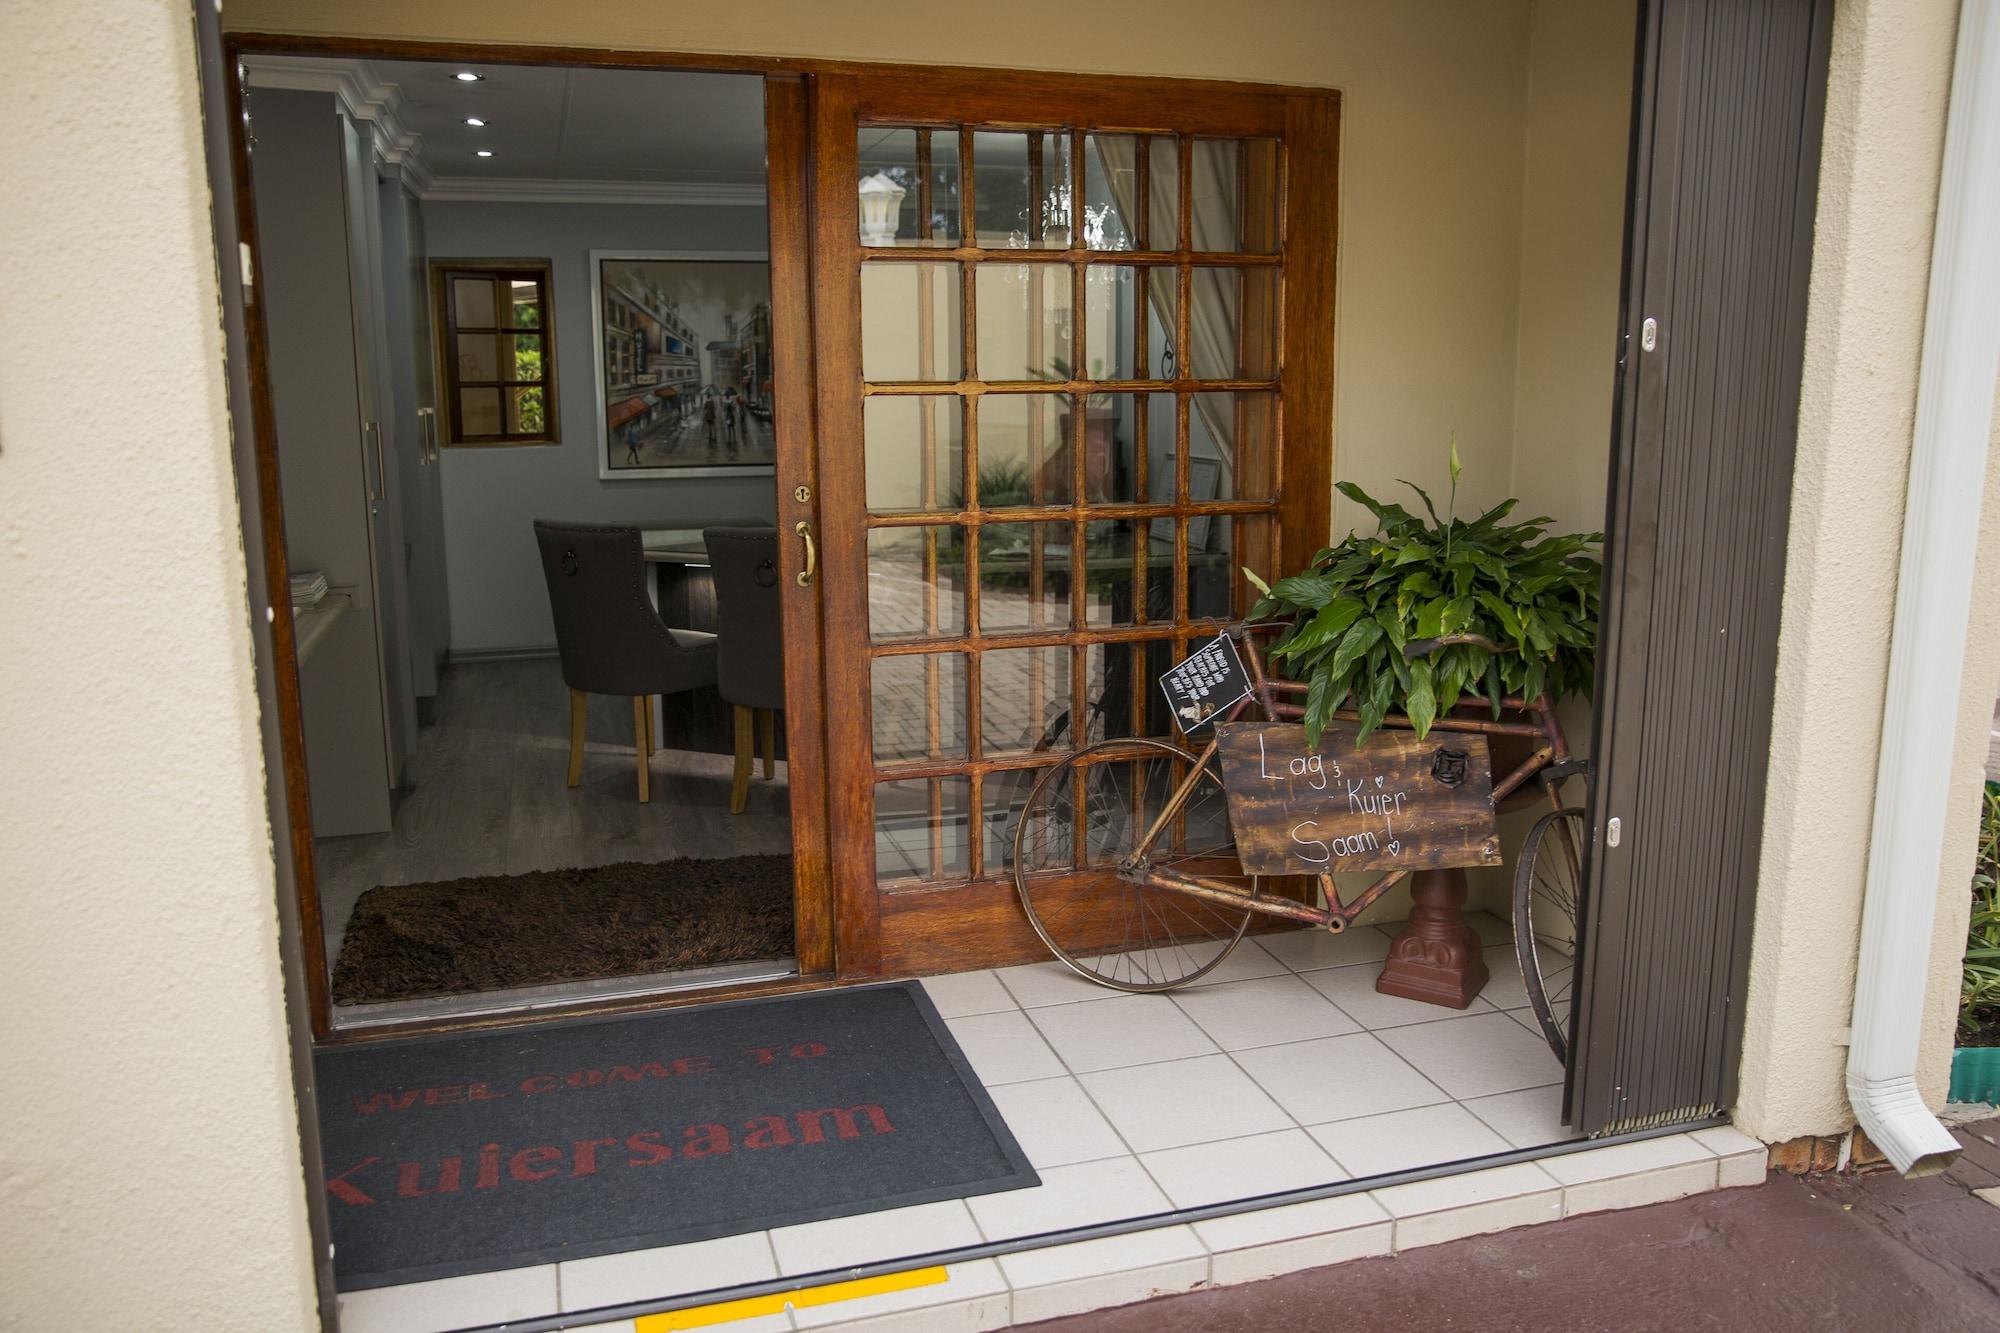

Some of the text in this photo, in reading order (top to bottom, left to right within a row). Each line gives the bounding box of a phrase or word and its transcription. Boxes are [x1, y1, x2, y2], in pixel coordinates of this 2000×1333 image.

[1259, 732, 1327, 790] Lag
[1347, 776, 1407, 815] Kuier
[352, 1040, 829, 1115] WELCOME TO
